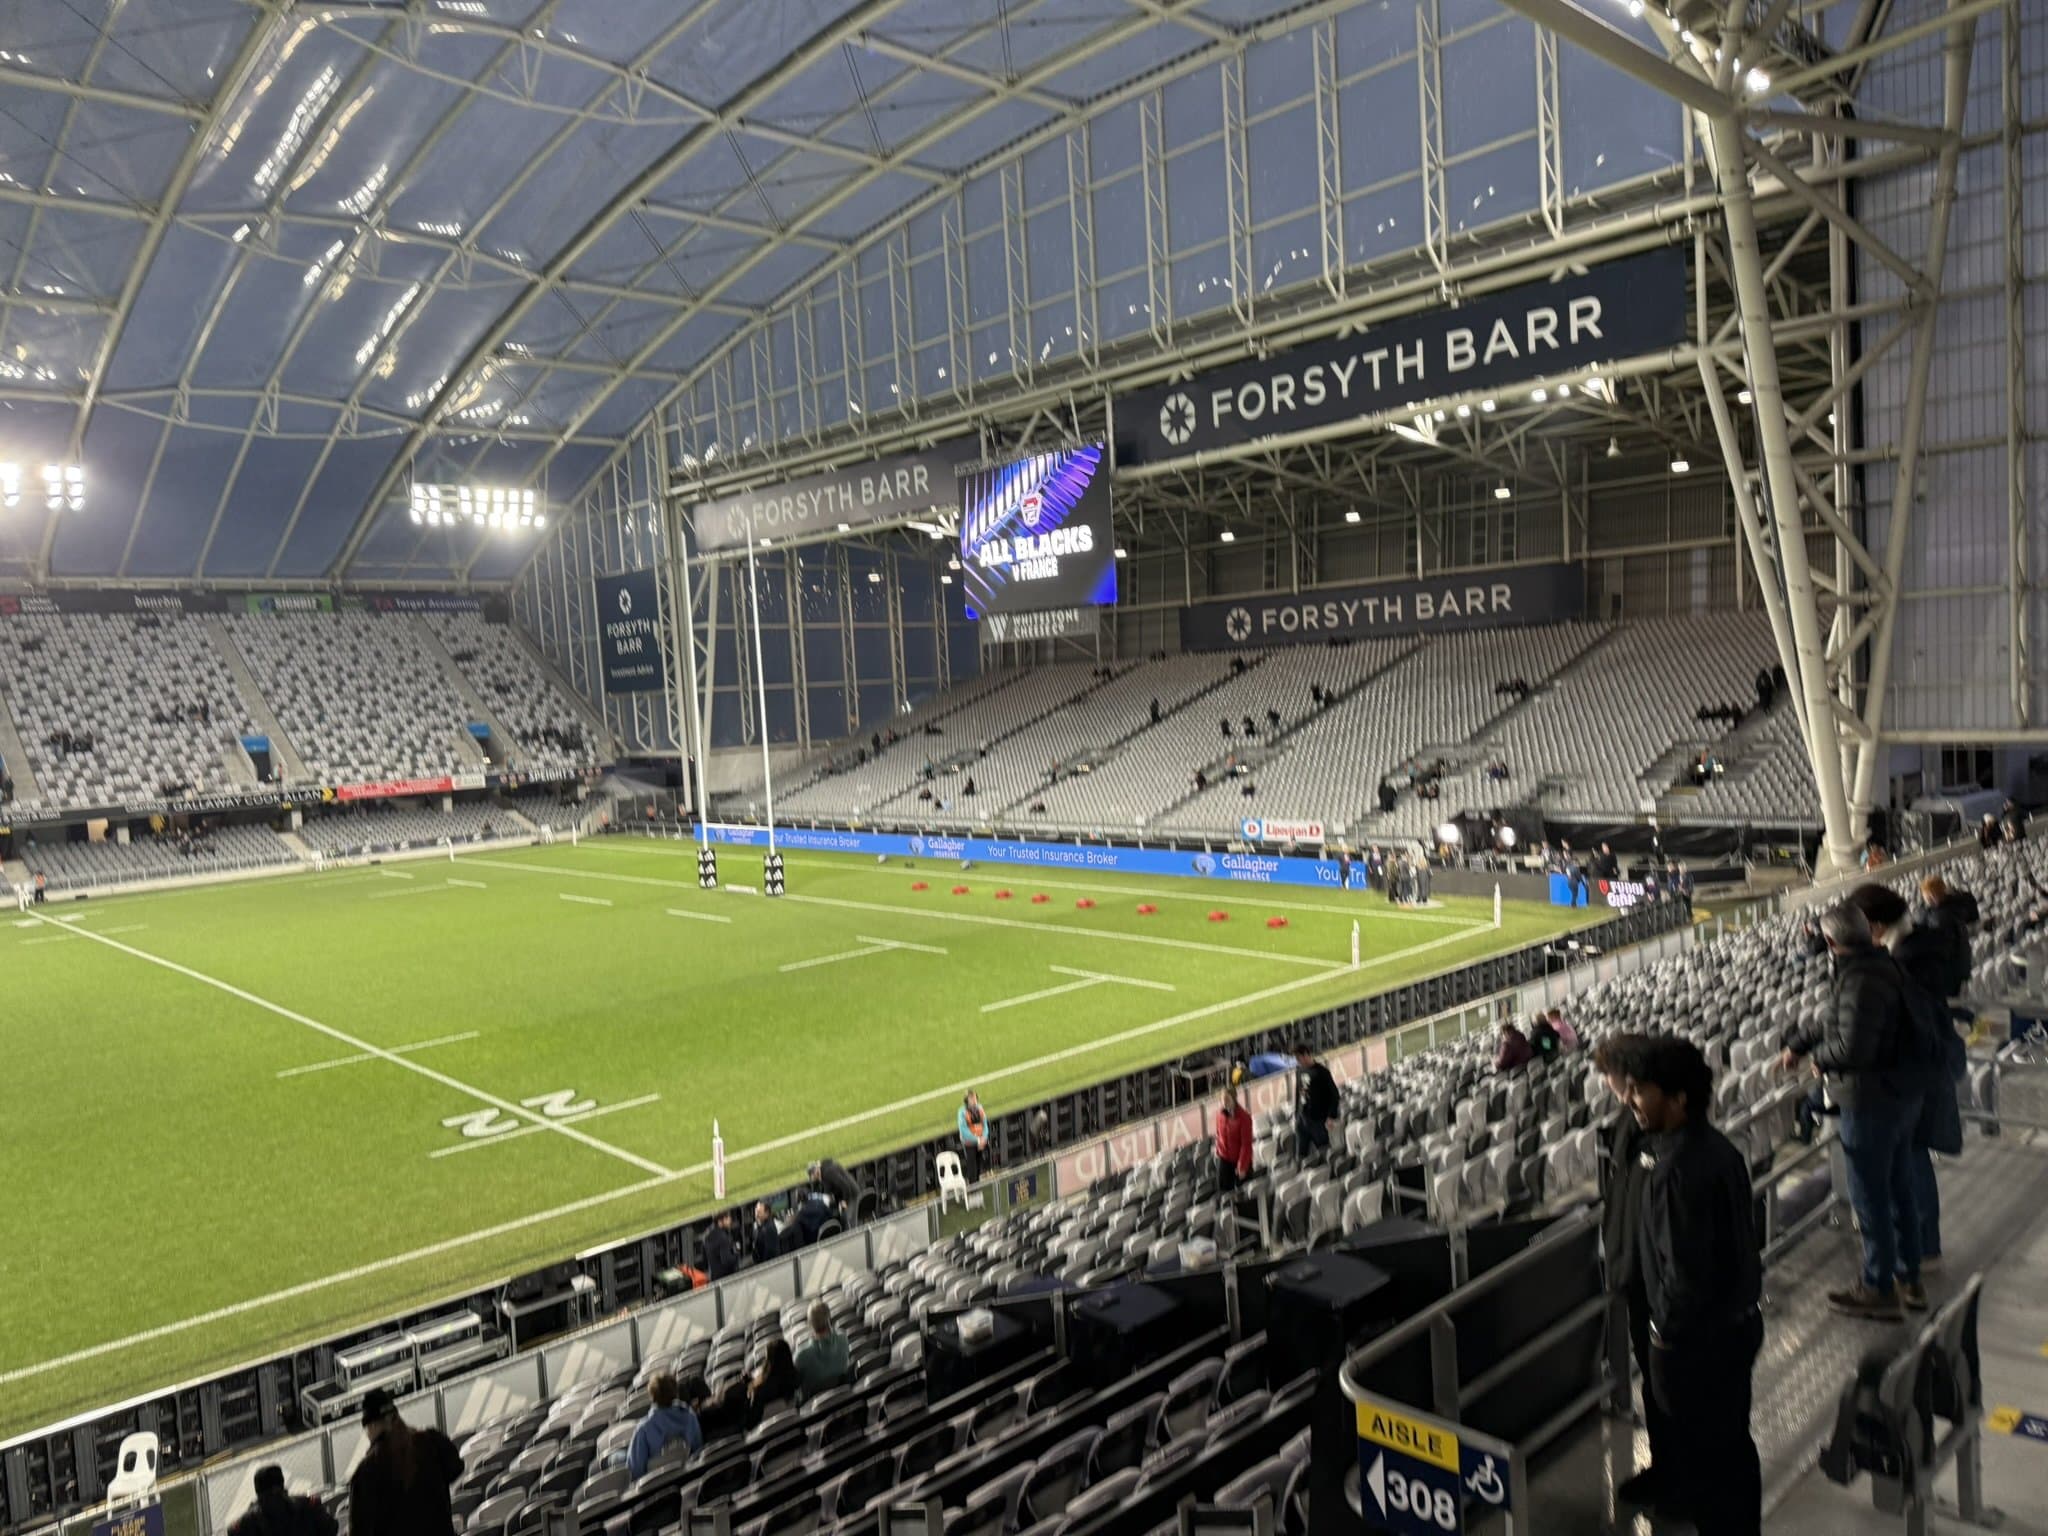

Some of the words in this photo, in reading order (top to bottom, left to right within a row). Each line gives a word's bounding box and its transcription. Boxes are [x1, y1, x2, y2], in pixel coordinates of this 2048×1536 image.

[1211, 338, 1425, 429] FORSYTH
[1446, 295, 1603, 373] BARR
[752, 481, 853, 529] FORSYTH
[860, 464, 930, 506] BARR
[979, 539, 1013, 567] ALL
[1014, 525, 1093, 560] BLACKS
[1021, 556, 1059, 581] FRANCE
[1262, 594, 1403, 634] FORSYTH
[1415, 584, 1513, 621] BARR
[607, 617, 651, 639] FORSYTH
[616, 637, 643, 656] BARR
[287, 790, 321, 803] ALLAN
[928, 838, 964, 853] Gallagher
[987, 845, 1006, 857] Your
[1009, 846, 1039, 860] Trusted
[1042, 848, 1084, 863] Insurance
[1087, 850, 1118, 865] Broker
[1222, 855, 1278, 872] Gallagher
[1371, 1414, 1443, 1459] AISLE
[1387, 1469, 1456, 1532] 308
